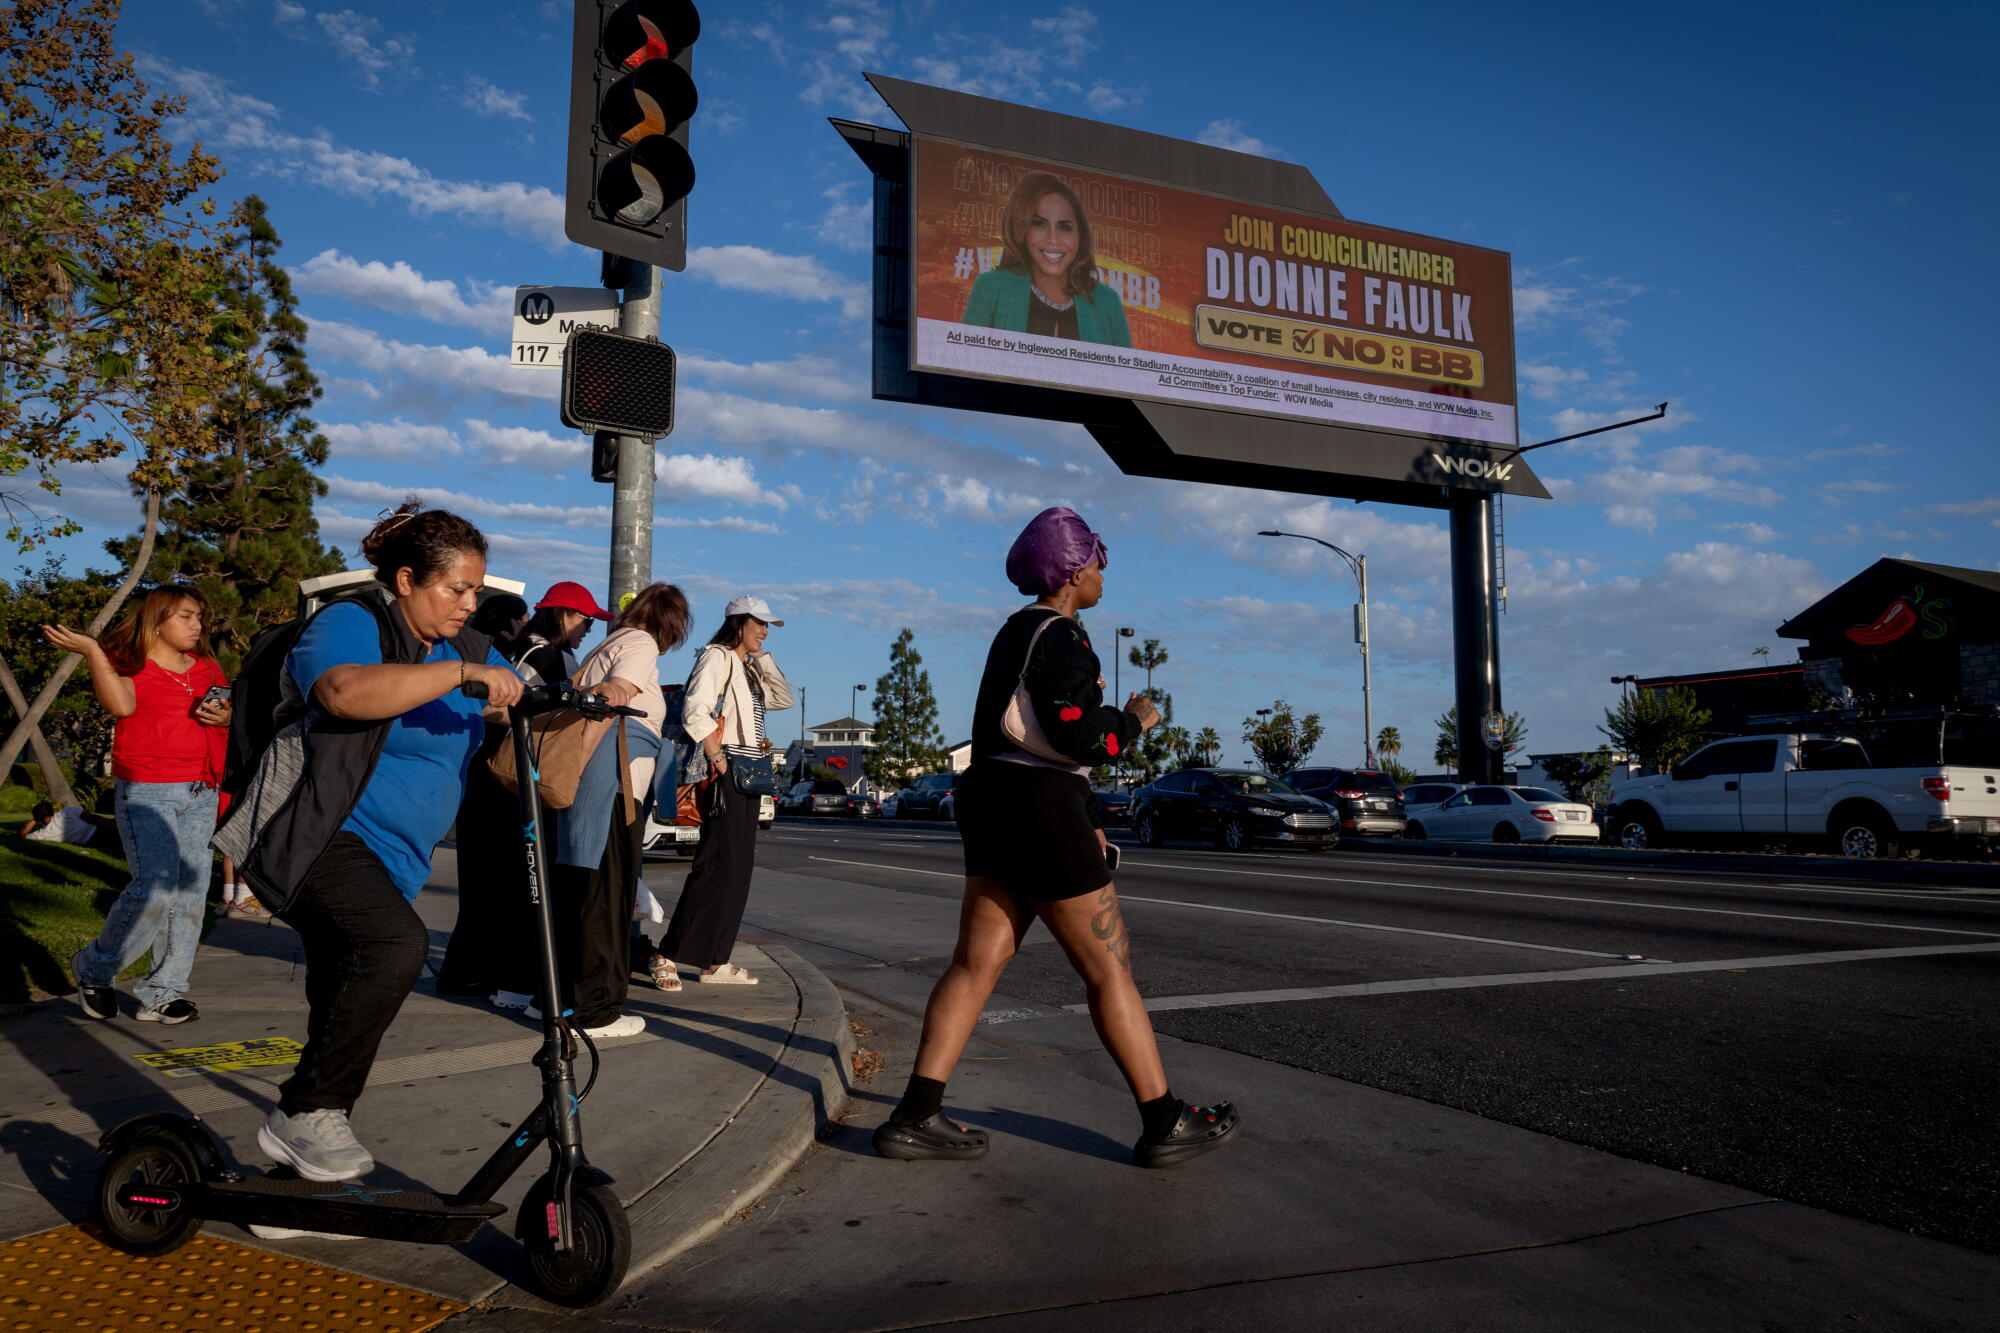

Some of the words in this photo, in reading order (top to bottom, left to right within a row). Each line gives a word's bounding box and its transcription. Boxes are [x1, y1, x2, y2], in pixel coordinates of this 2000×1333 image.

[1224, 214, 1274, 252] JOIN
[1281, 224, 1455, 286] COUNCILMEMBER
[1206, 247, 1348, 321] DIONNE
[1364, 276, 1474, 343] FAULK
[517, 345, 549, 362] 117
[947, 331, 961, 341] Ad
[964, 334, 985, 346] paid
[988, 337, 1002, 347] for
[1004, 338, 1016, 350] by
[1018, 340, 1068, 356] Inglewood
[1070, 349, 1116, 363] Residents
[1118, 355, 1131, 365] for
[1133, 357, 1170, 371] Stadium
[1172, 363, 1235, 382] Accountability,
[1244, 375, 1279, 387] coalition
[1281, 379, 1290, 388] of
[1291, 381, 1313, 392] small
[1314, 383, 1362, 400] businesses,
[1363, 390, 1377, 402] city
[1379, 395, 1416, 408] residents,
[1418, 399, 1432, 409] and
[1433, 401, 1455, 412] WOW
[1456, 405, 1480, 417] Media,
[1481, 409, 1494, 419] Inc.
[1207, 317, 1282, 345] VOTE
[1323, 333, 1385, 365] NO
[1411, 346, 1474, 381] BB
[1159, 374, 1171, 385] Ad
[1173, 376, 1227, 392] Committee's
[1229, 383, 1245, 396] Top
[1247, 386, 1279, 400] Funder:
[1284, 393, 1308, 406] WOW
[1309, 396, 1334, 408] Media
[526, 843, 540, 904] HOVER-1
